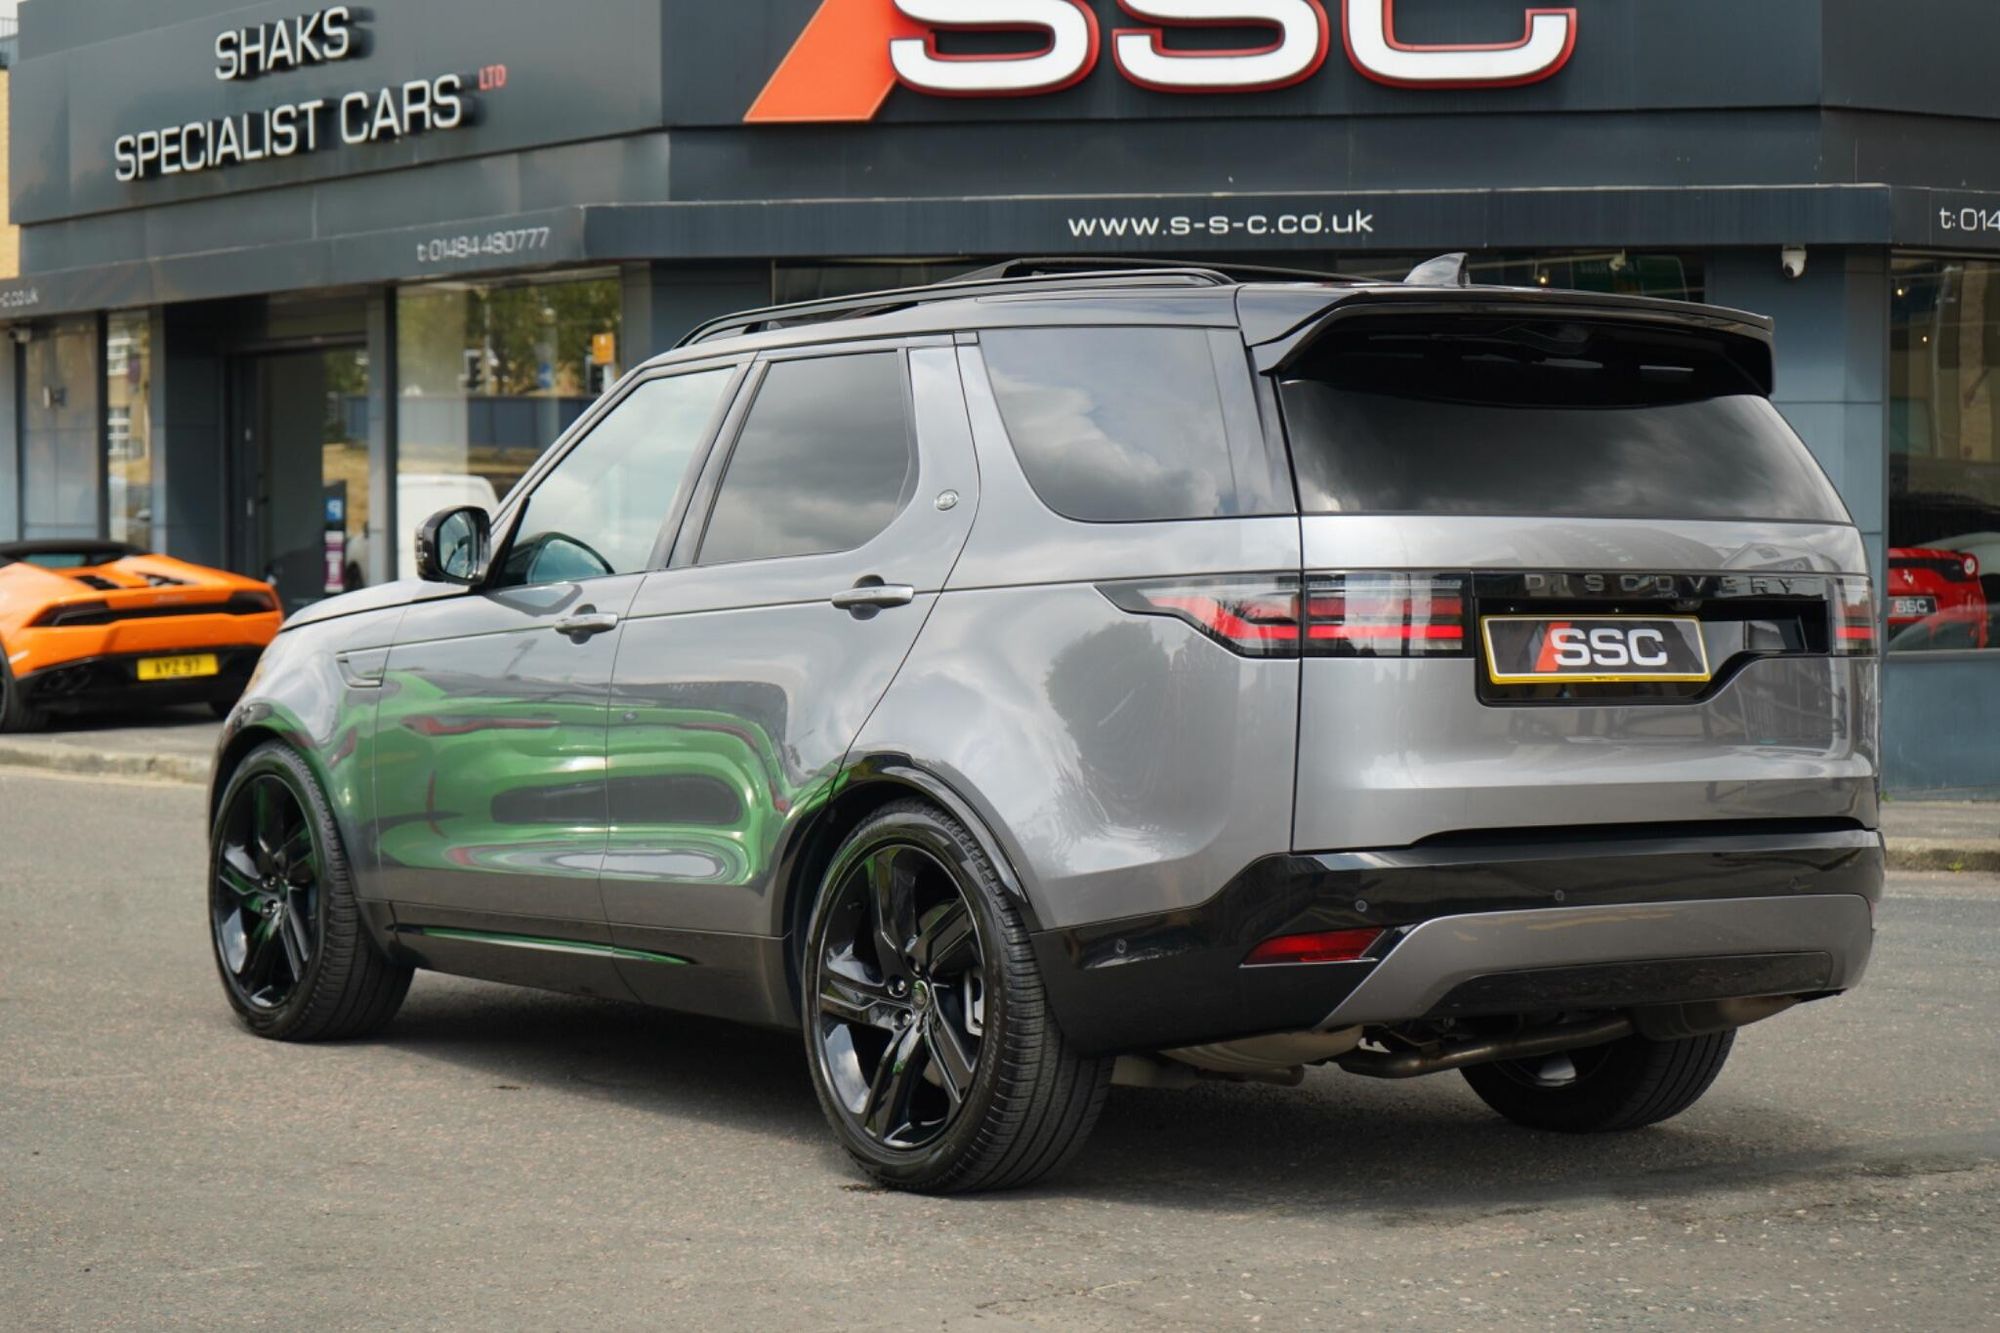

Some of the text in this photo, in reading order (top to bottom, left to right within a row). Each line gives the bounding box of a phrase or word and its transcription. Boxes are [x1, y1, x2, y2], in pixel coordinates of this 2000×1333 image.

[214, 6, 350, 80] SHAKS
[114, 64, 508, 182] SPECIALIST CARS LTD
[1067, 209, 1374, 237] www.s-s-c.co.uk
[1524, 573, 1796, 594] DISCOVERY
[1895, 599, 1928, 614] SSC
[1550, 627, 1668, 667] SSC
